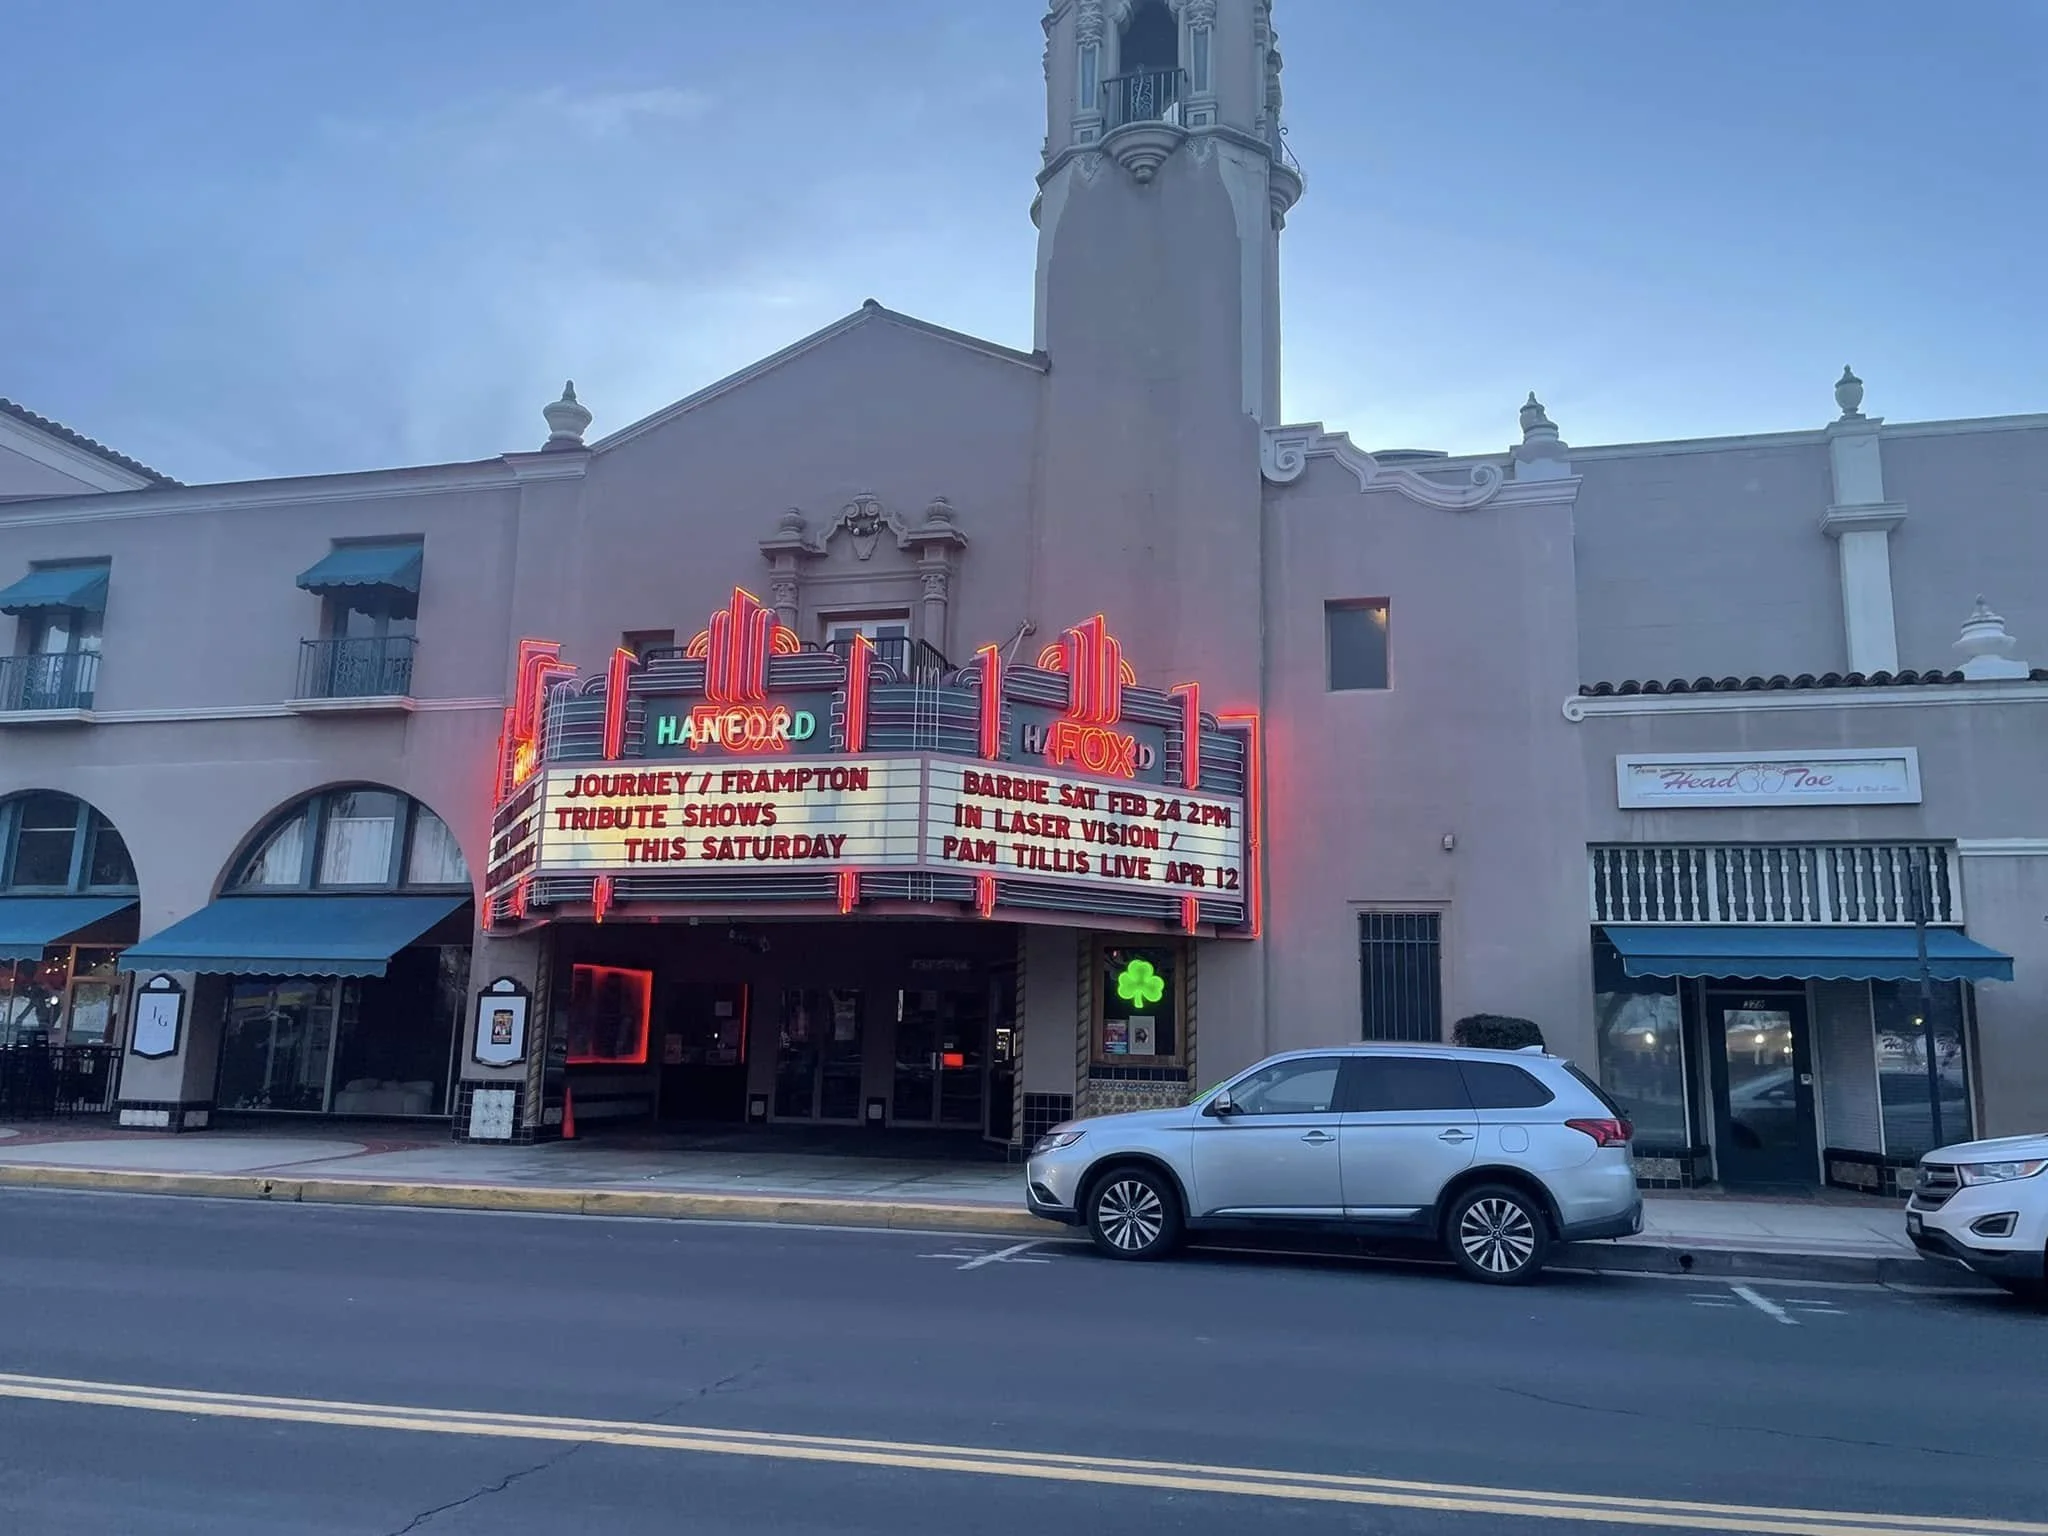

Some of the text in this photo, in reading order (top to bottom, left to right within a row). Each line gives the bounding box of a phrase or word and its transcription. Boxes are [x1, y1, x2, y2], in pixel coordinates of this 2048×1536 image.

[657, 711, 816, 745] HANFORD
[690, 705, 785, 751] FOX
[1056, 721, 1135, 778] FOX
[565, 771, 692, 798] JOURNEY
[721, 766, 869, 794] FRAMPTON
[1660, 769, 1739, 790] Head
[1783, 767, 1832, 788] Toe
[555, 804, 668, 830] TRIBUTE
[682, 803, 777, 828] SHOWS
[963, 770, 1232, 829] BARBIE SAT FEB 24 2PM
[954, 803, 982, 830] IN
[995, 808, 1071, 840] LASER
[1080, 819, 1159, 850] VISION
[624, 834, 847, 863] THIS SATURDAY
[943, 835, 1239, 890] PAM TILLIS LIVE APR 12
